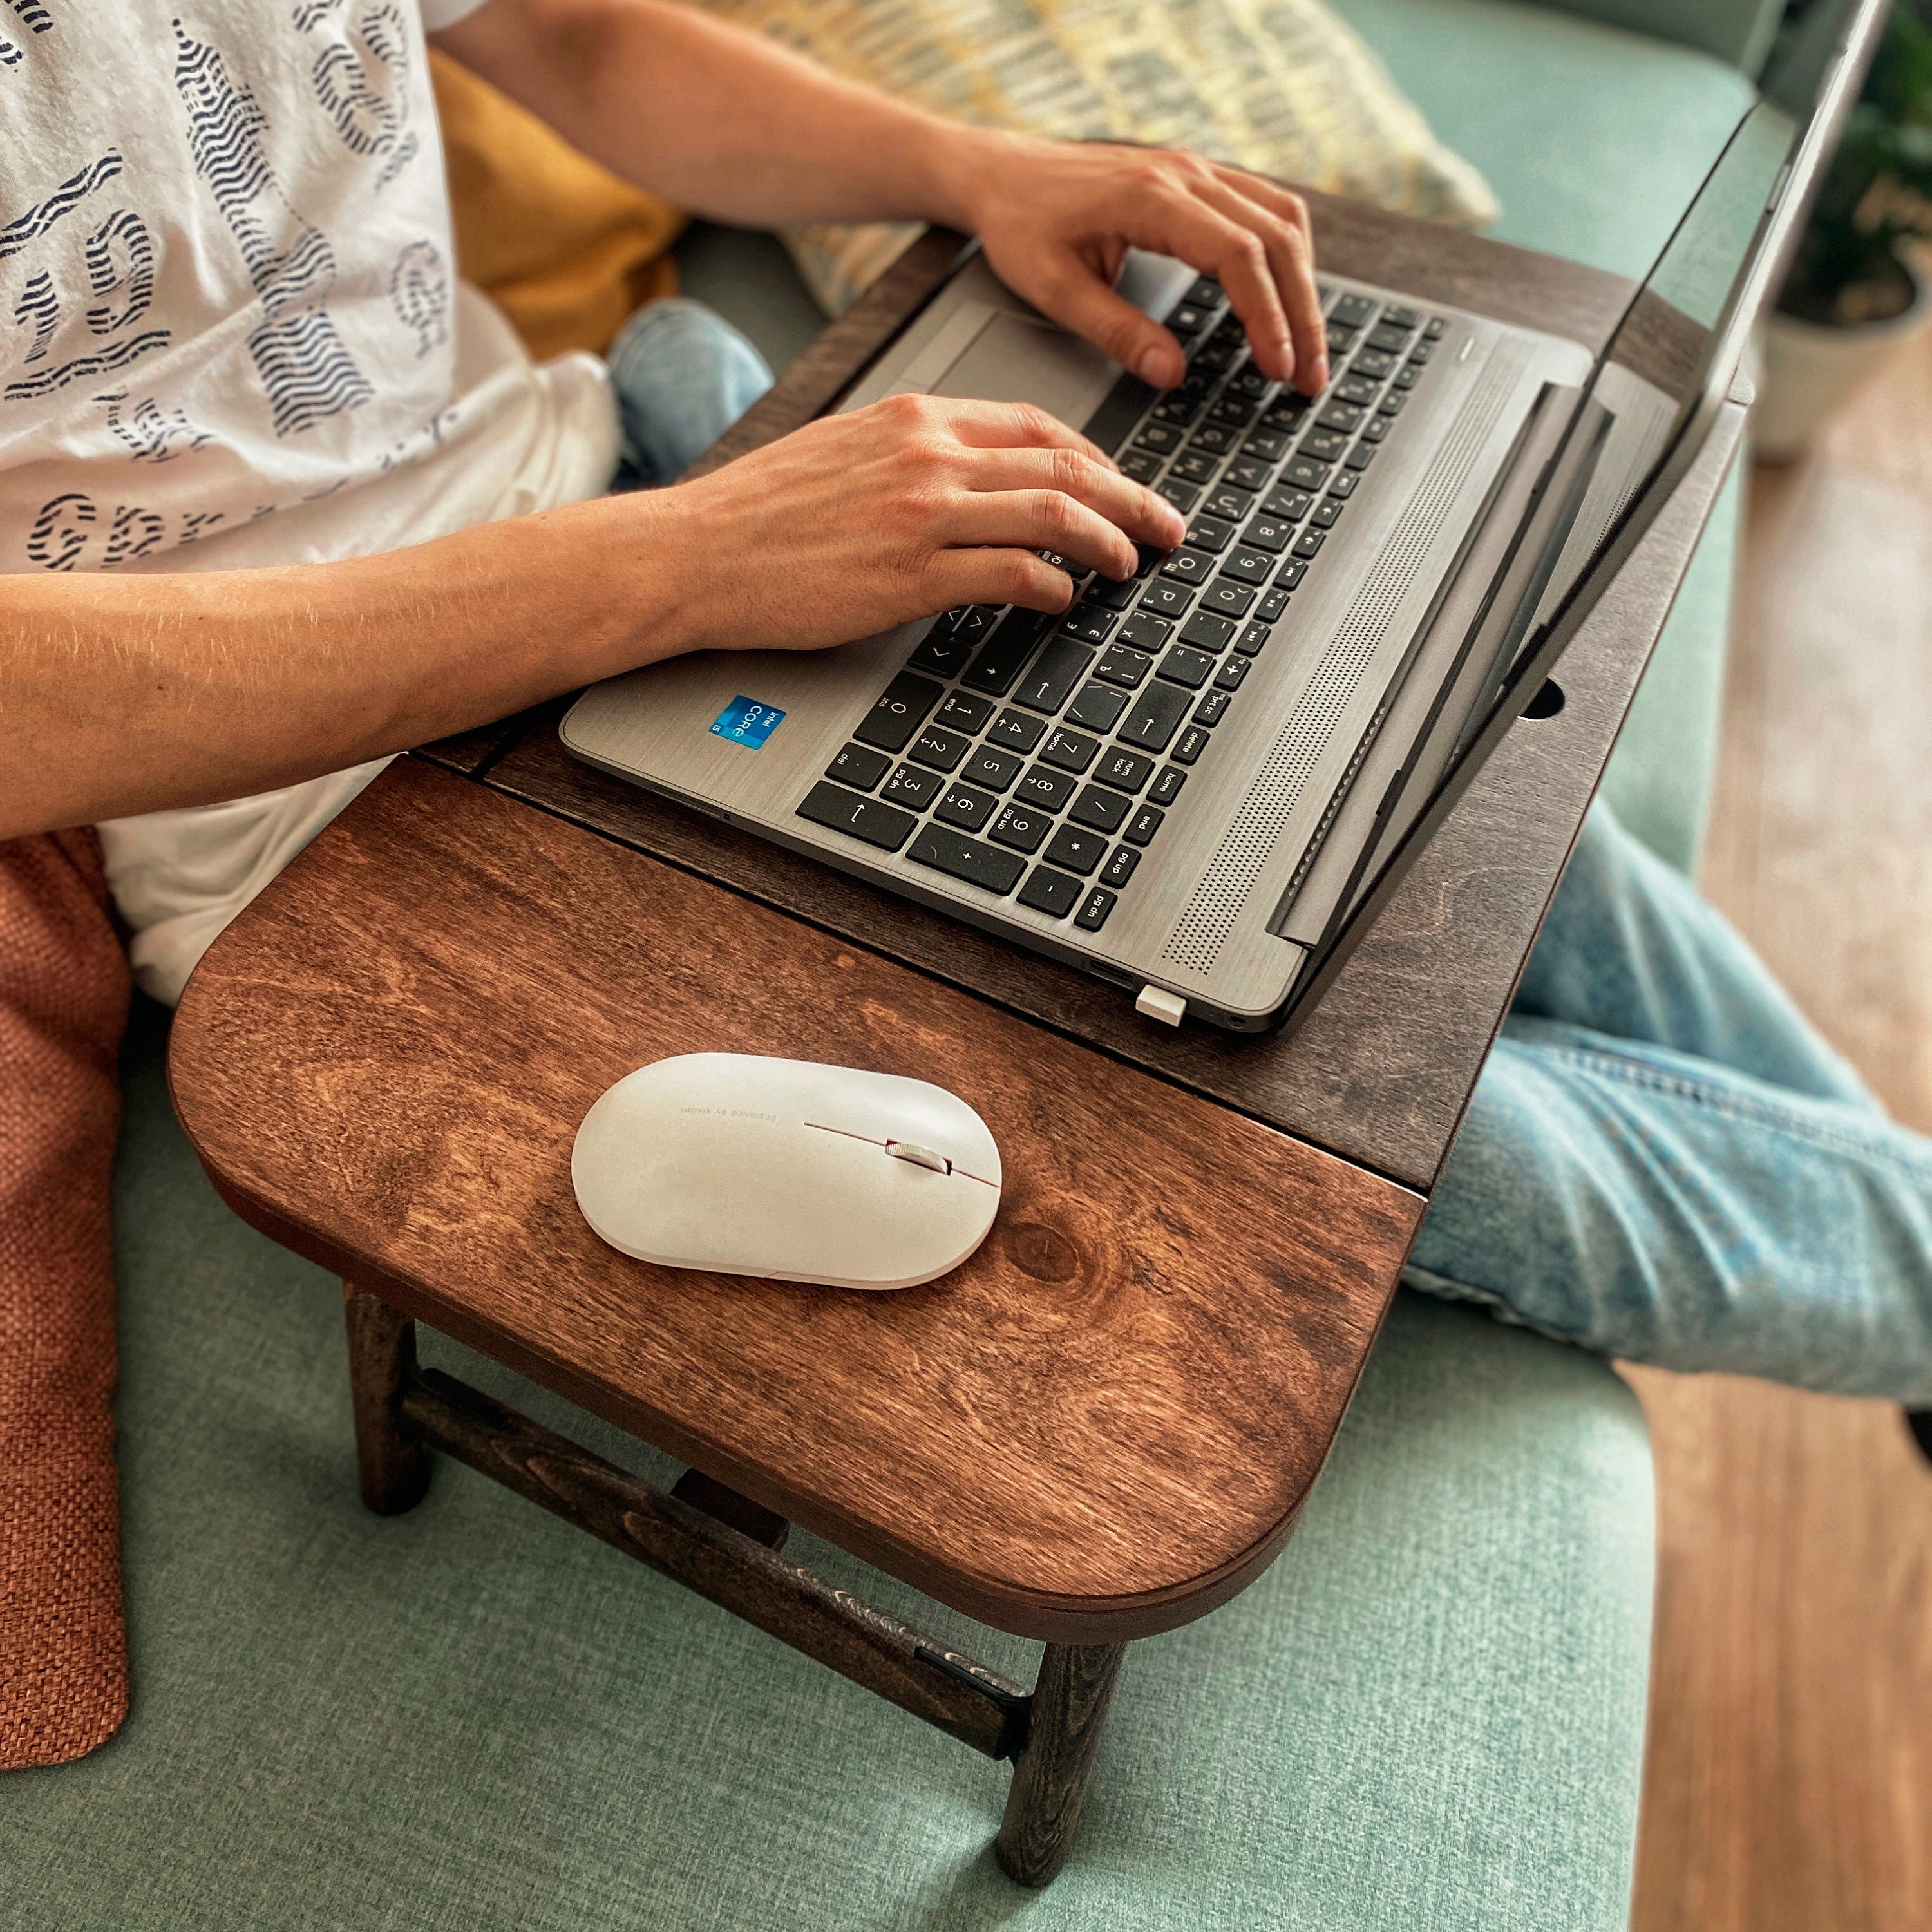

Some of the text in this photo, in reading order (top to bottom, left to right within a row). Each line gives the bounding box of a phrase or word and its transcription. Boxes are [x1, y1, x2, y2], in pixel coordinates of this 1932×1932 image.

[1256, 438, 1276, 450] T
[1185, 458, 1204, 473] H
[1238, 467, 1256, 479] Y
[1218, 495, 1238, 508] U
[1280, 498, 1294, 506] 7
[1260, 527, 1274, 536] 8
[1179, 558, 1195, 569] O
[1240, 558, 1255, 567] 9
[1161, 590, 1176, 601] P
[1220, 591, 1235, 600] 0
[878, 697, 889, 707] ins
[944, 698, 956, 712] end
[1204, 696, 1218, 714] prt sc
[891, 703, 907, 714] 0
[1008, 723, 1023, 734] 4
[929, 740, 946, 752] 2
[1047, 732, 1065, 752] home
[1063, 743, 1078, 753] 7
[1182, 732, 1198, 753] delete
[837, 753, 849, 765] del
[1112, 757, 1126, 773] lock
[983, 760, 1000, 772] 5
[1121, 761, 1134, 777] num
[889, 768, 907, 789] pg dn
[1159, 773, 1176, 792] home
[904, 779, 922, 791] 3
[1037, 780, 1054, 791] 8
[958, 799, 974, 811] 6
[998, 808, 1014, 829] pg up
[1138, 815, 1150, 830] end
[1013, 819, 1028, 831] 9
[1112, 852, 1129, 874] pg up
[1087, 895, 1104, 918] pg dn
